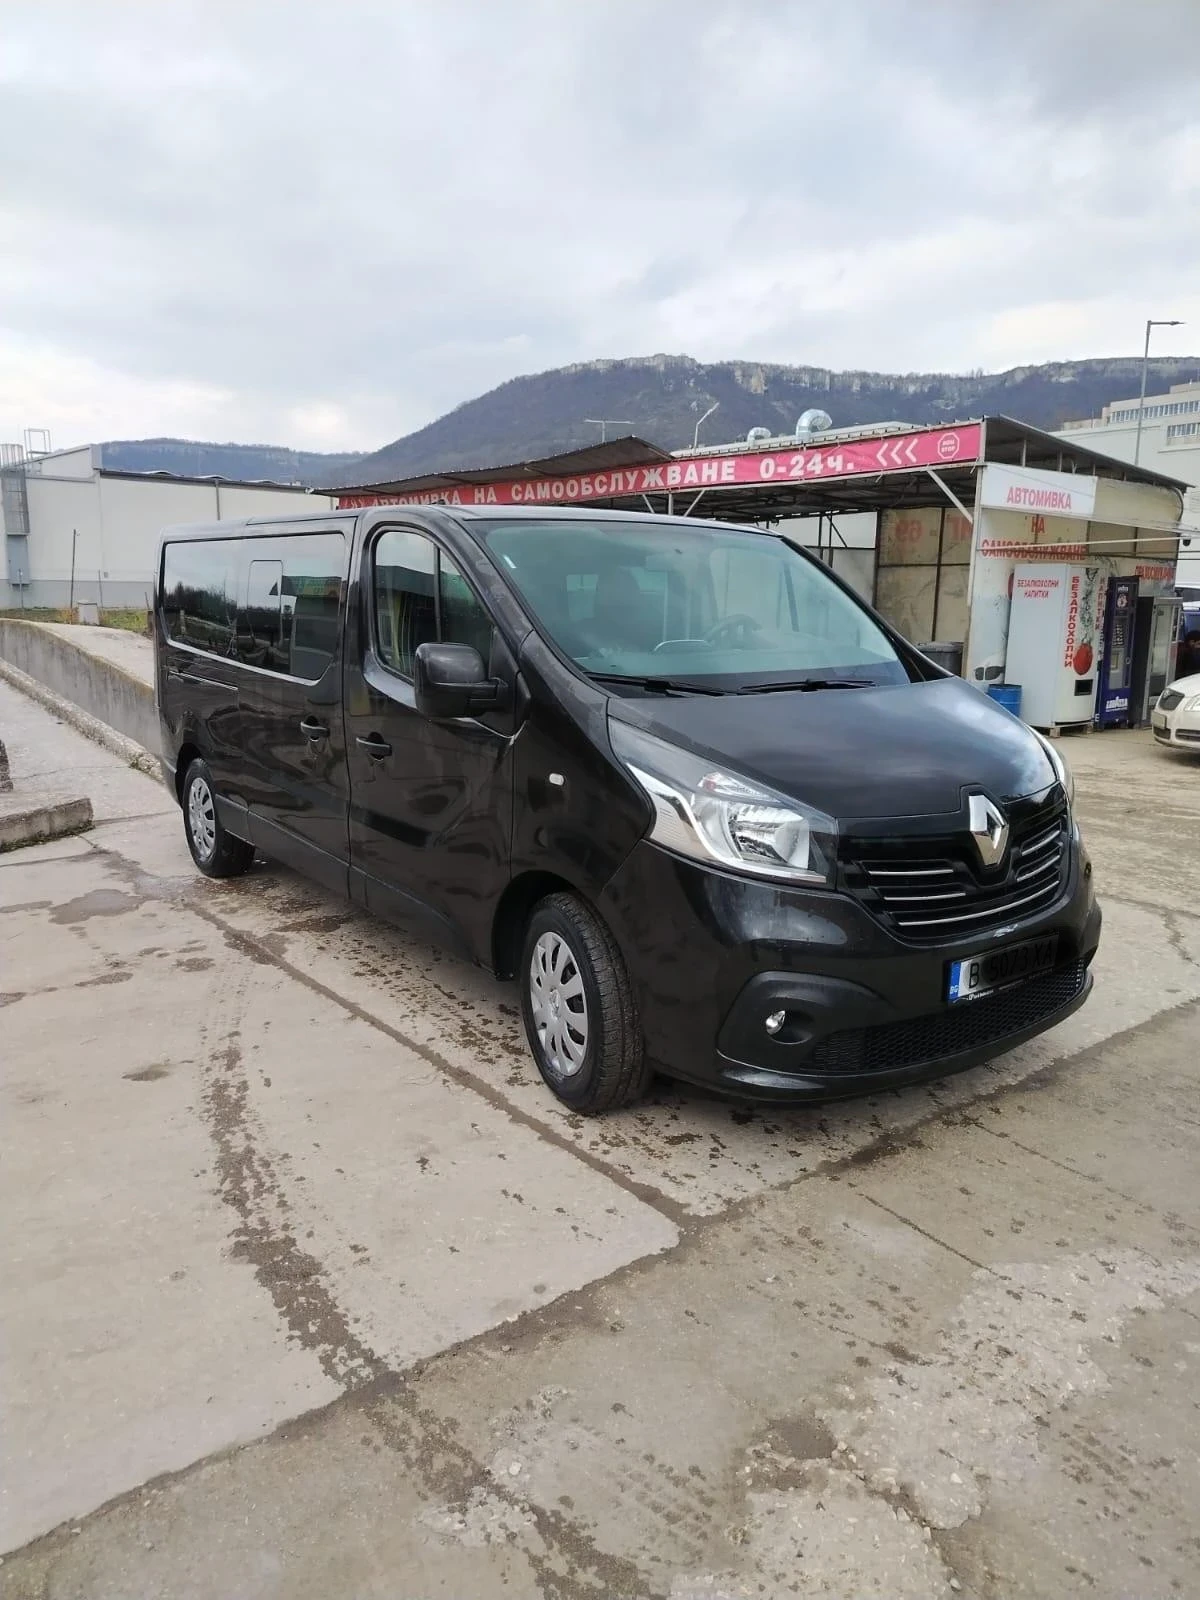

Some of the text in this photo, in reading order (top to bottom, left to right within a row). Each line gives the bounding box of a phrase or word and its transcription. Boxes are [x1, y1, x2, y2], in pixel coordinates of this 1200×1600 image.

[474, 486, 497, 504] НА
[511, 460, 736, 501] САМООБСЛУЖВАНЕ
[1006, 486, 1072, 509] АВТОМИВКА
[1031, 516, 1046, 534] НА
[1064, 576, 1080, 668] БЕЗАЛКОХОЛНИ
[968, 962, 980, 989] B
